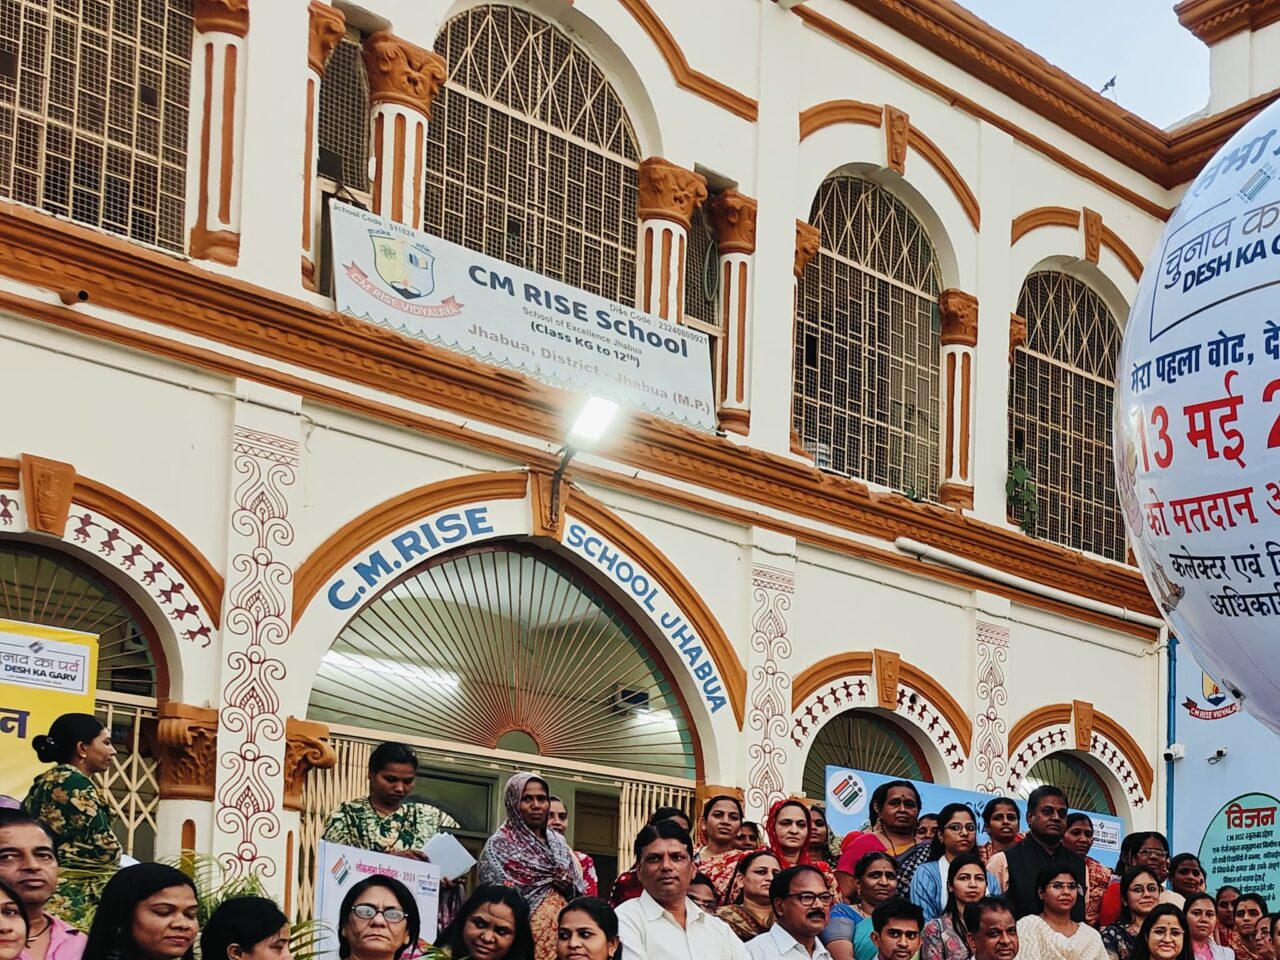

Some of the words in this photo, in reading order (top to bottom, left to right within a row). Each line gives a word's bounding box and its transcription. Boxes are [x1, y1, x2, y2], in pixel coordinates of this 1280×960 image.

[332, 202, 360, 219] School
[361, 213, 382, 227] Code
[1165, 216, 1237, 287] चुनाव
[1181, 255, 1233, 294] DESH
[1235, 238, 1268, 271] KA
[349, 273, 373, 293] CM
[373, 290, 400, 308] RISE
[400, 303, 459, 317] VIDYALAYA
[468, 264, 516, 298] CM
[523, 283, 589, 323] RISE
[595, 309, 689, 358] School
[630, 311, 652, 325] Code
[522, 306, 554, 324] School
[555, 318, 564, 328] of
[565, 321, 611, 344] Excellence
[612, 339, 643, 355] Jhabua
[531, 320, 572, 343] (Class
[574, 335, 594, 351] KG
[597, 344, 611, 357] to
[467, 322, 536, 358] Jhabua,
[540, 344, 601, 377] District
[614, 371, 669, 399] Jhabua
[672, 391, 711, 416] (M.P.)
[1131, 359, 1152, 395] मेरा
[1155, 349, 1201, 384] पहला
[1208, 330, 1254, 368] वोट,
[1138, 404, 1175, 474] 13
[1182, 369, 1248, 470] मई
[1144, 487, 1171, 536] को
[1168, 486, 1259, 535] मतदान
[1168, 544, 1232, 581] कलेक्टर
[1231, 543, 1264, 585] एवं
[565, 523, 660, 614] SCHOOL
[659, 611, 728, 715] JHABUA
[4, 664, 31, 675] DESH
[32, 669, 48, 678] KA
[48, 671, 77, 682] GARV
[34, 656, 55, 670] का
[57, 659, 80, 672] पर्व
[1225, 802, 1278, 829] विजन
